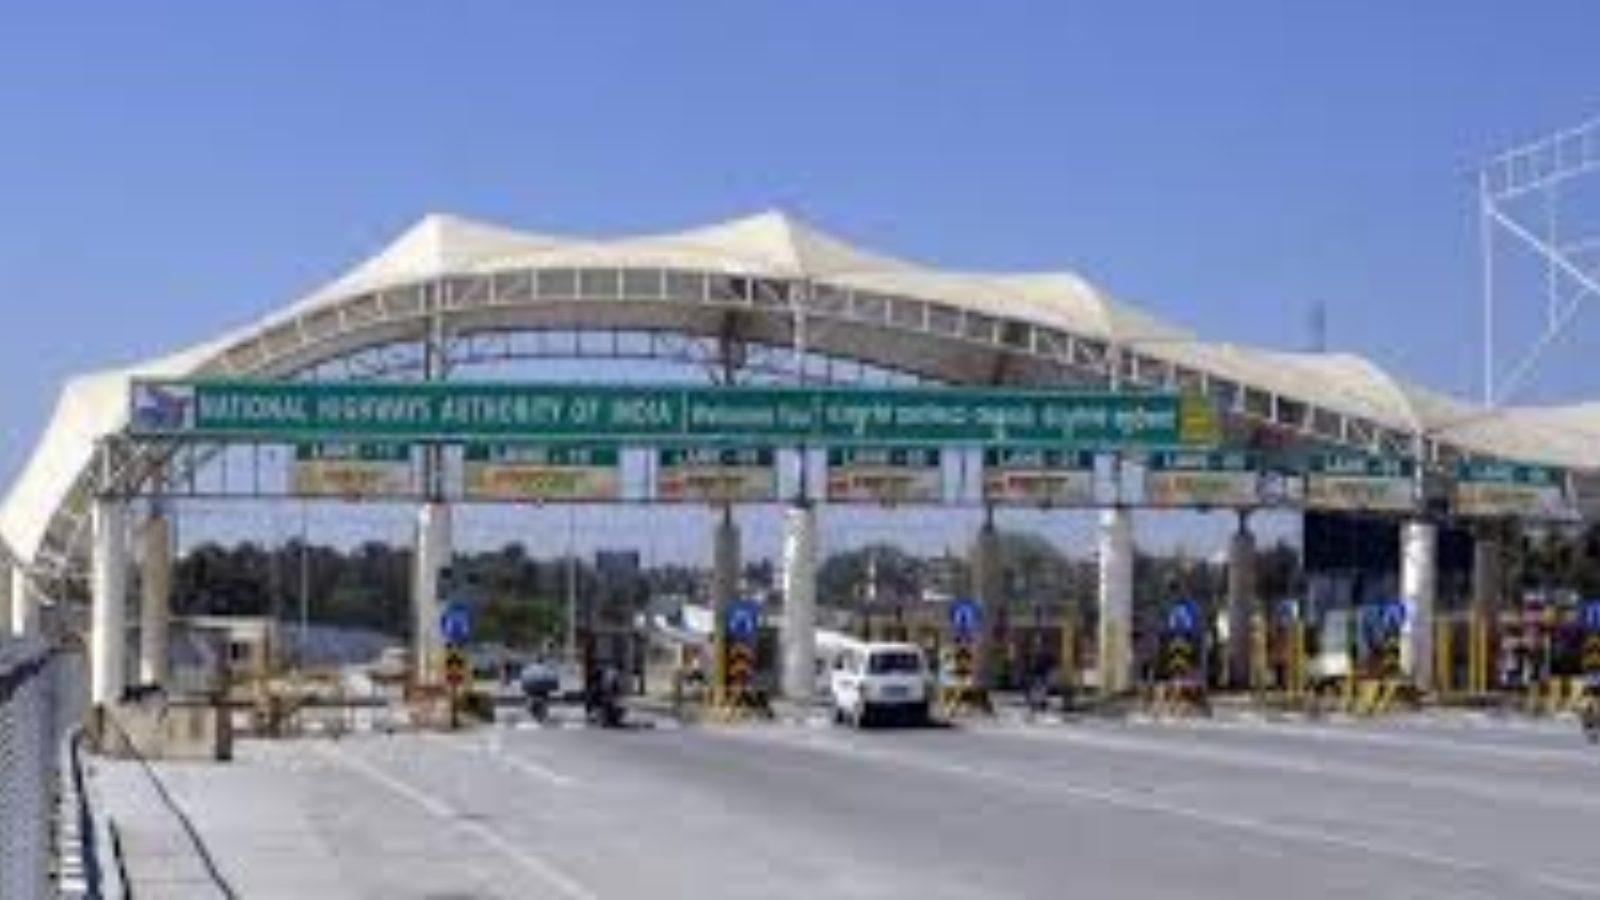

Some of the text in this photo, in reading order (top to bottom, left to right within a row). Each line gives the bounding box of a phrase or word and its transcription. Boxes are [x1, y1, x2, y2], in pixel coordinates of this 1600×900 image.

[199, 395, 673, 428] NATIONAL HIGHWAYS AUTHORITY OF INDIA
